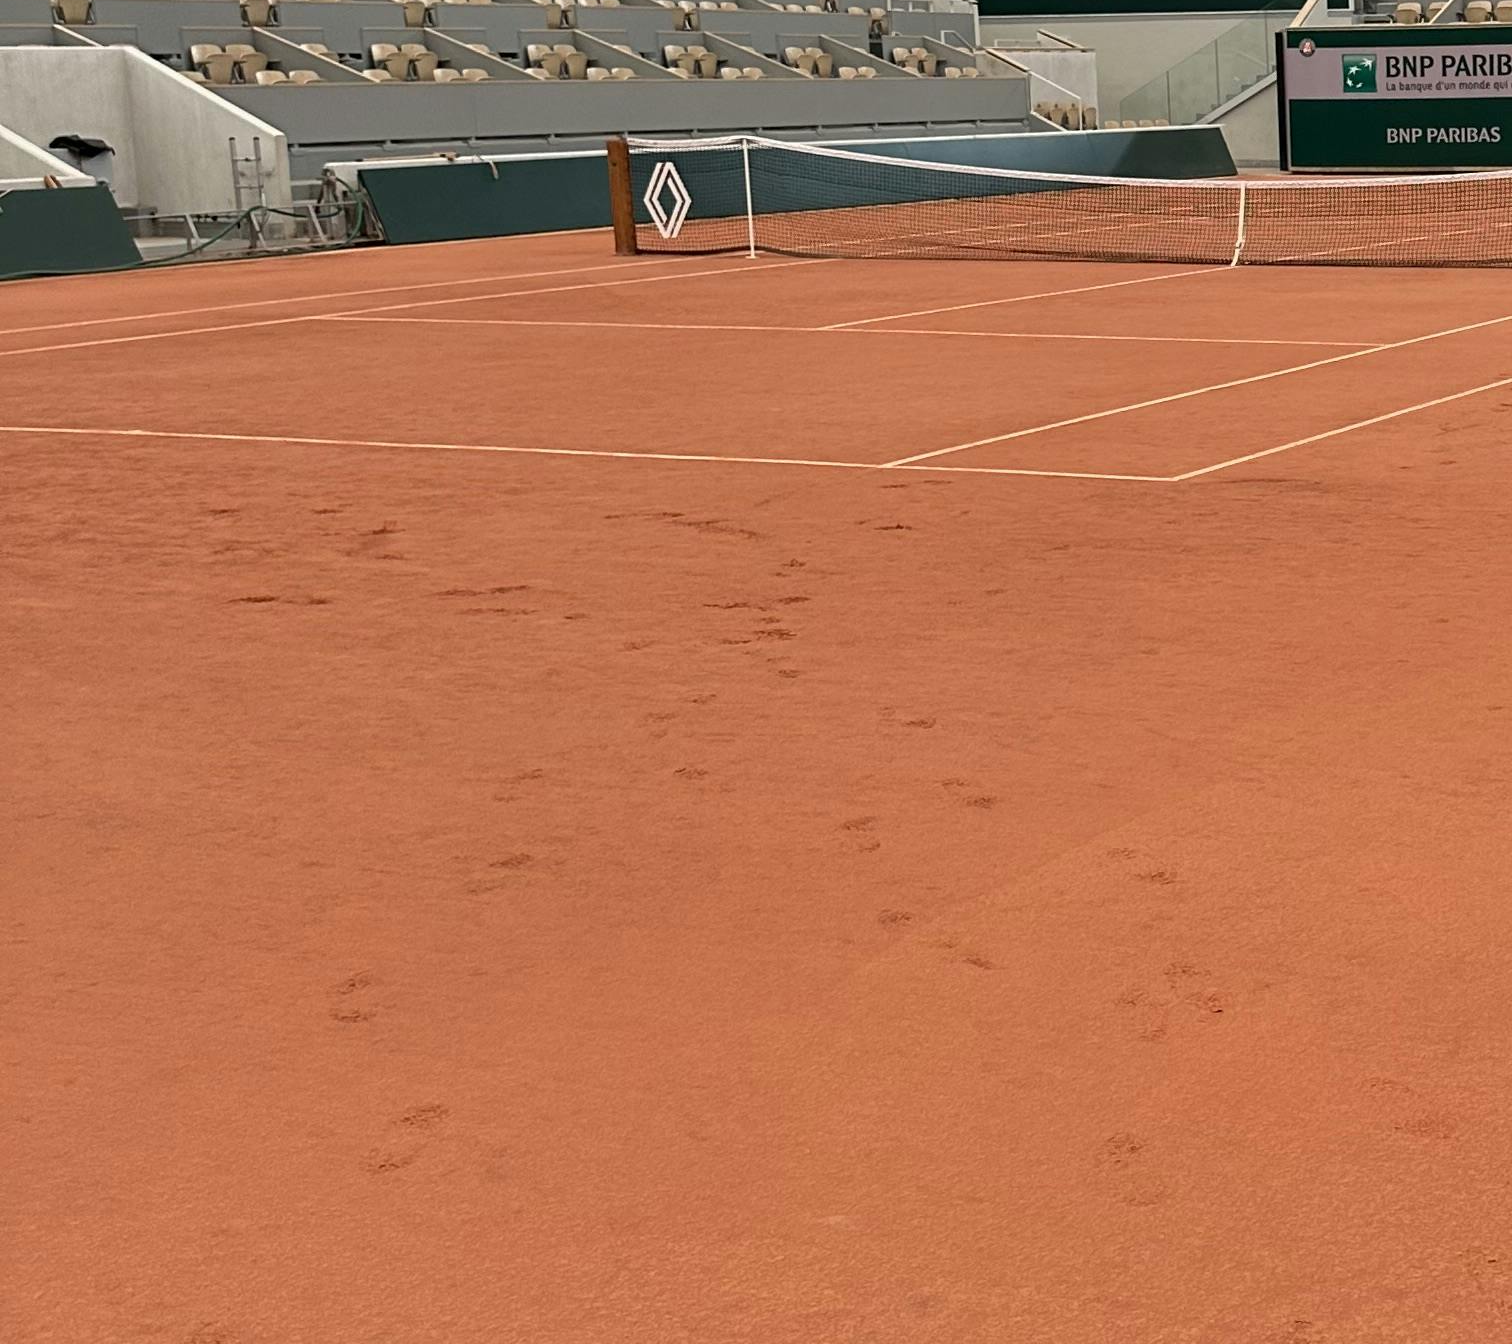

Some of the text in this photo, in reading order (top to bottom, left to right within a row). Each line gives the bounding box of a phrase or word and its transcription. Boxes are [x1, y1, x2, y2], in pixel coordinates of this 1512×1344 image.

[1385, 55, 1434, 78] BNP
[1386, 81, 1396, 91] La
[1399, 81, 1432, 92] banque
[1435, 81, 1456, 90] d'un
[1459, 80, 1490, 90] monde
[1493, 80, 1508, 91] qui
[1386, 126, 1501, 143] BNP PARIBAS
